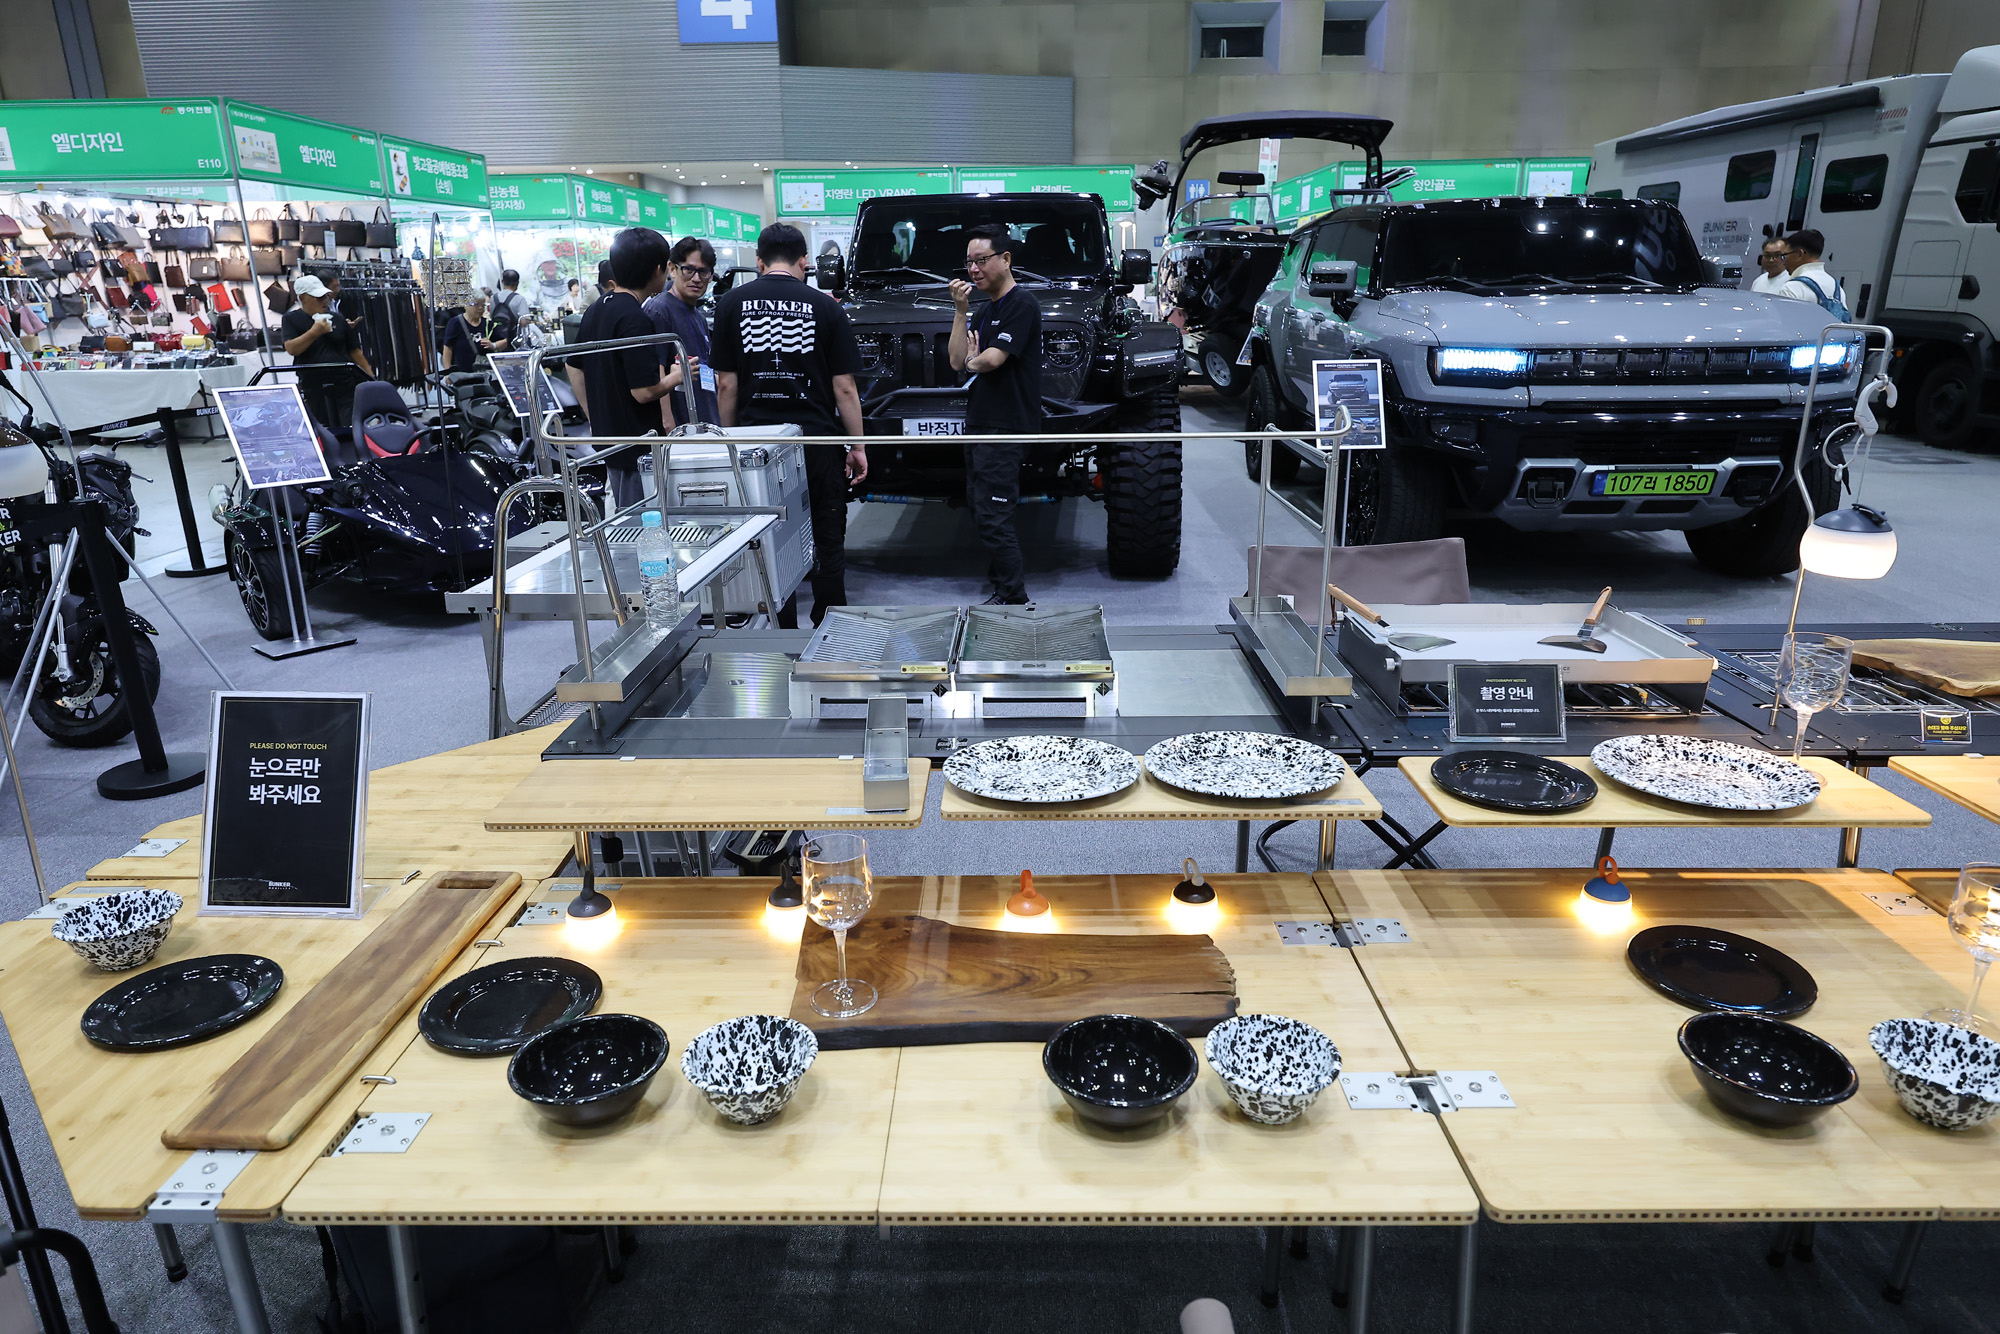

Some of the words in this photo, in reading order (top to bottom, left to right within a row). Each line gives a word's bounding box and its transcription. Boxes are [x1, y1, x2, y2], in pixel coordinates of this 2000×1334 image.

[51, 132, 124, 153] 엘디자인
[198, 158, 221, 168] E110
[299, 144, 337, 168] 엘디자인
[1412, 179, 1456, 192] 정인골프
[825, 188, 853, 200] 지영란
[856, 188, 876, 199] LED
[741, 299, 814, 314] BUNKER
[196, 406, 219, 416] BUNKER
[1610, 475, 1658, 492] 107러
[1664, 474, 1709, 492] 1850
[1480, 686, 1506, 701] 촬영
[1508, 686, 1534, 701] 안내
[249, 742, 274, 750] PLEASE
[249, 757, 321, 778] 눈으로만
[249, 783, 322, 805] 봐주세요
